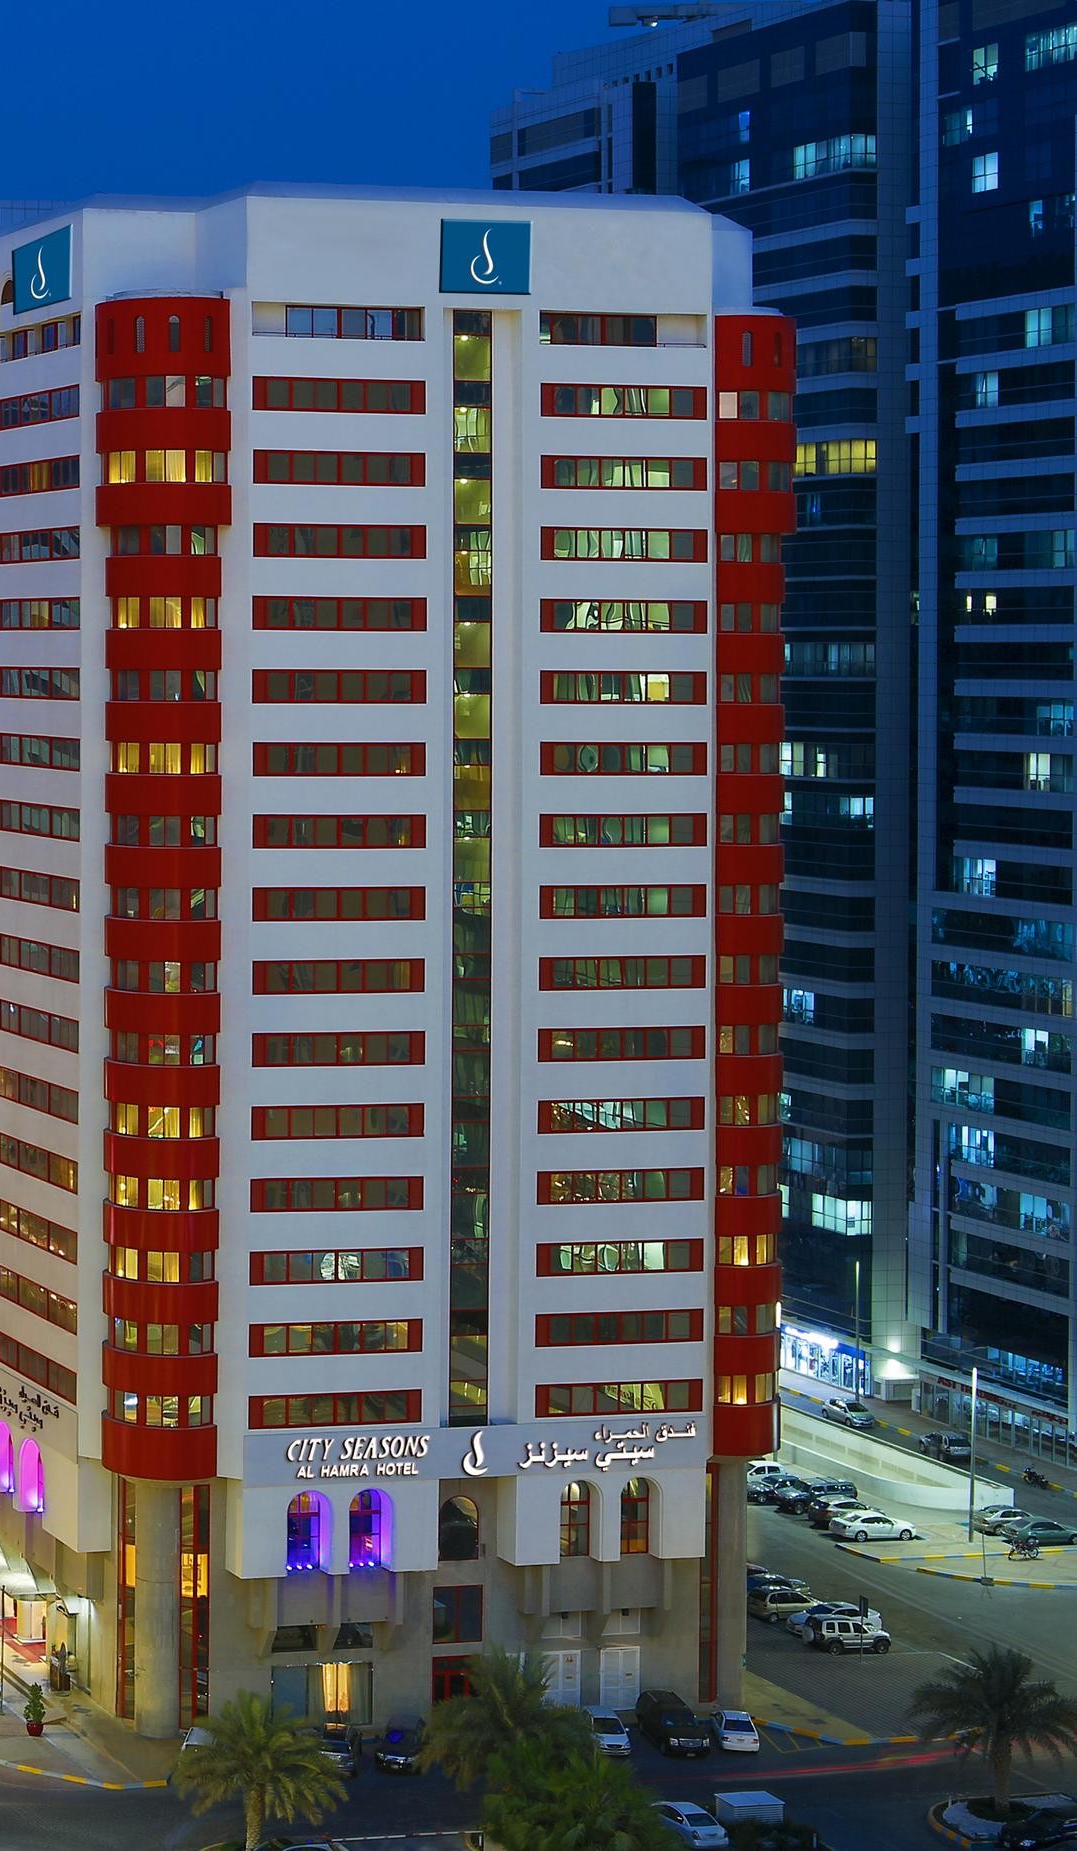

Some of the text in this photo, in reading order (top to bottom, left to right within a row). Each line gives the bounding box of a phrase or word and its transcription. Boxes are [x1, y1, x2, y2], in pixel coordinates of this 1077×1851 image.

[594, 1420, 698, 1446] فندق الحمراء
[286, 1434, 431, 1463] CITY SEASONS
[518, 1440, 656, 1472] سيتي سيزنز
[296, 1462, 419, 1479] AL HAMRA HOTEL
